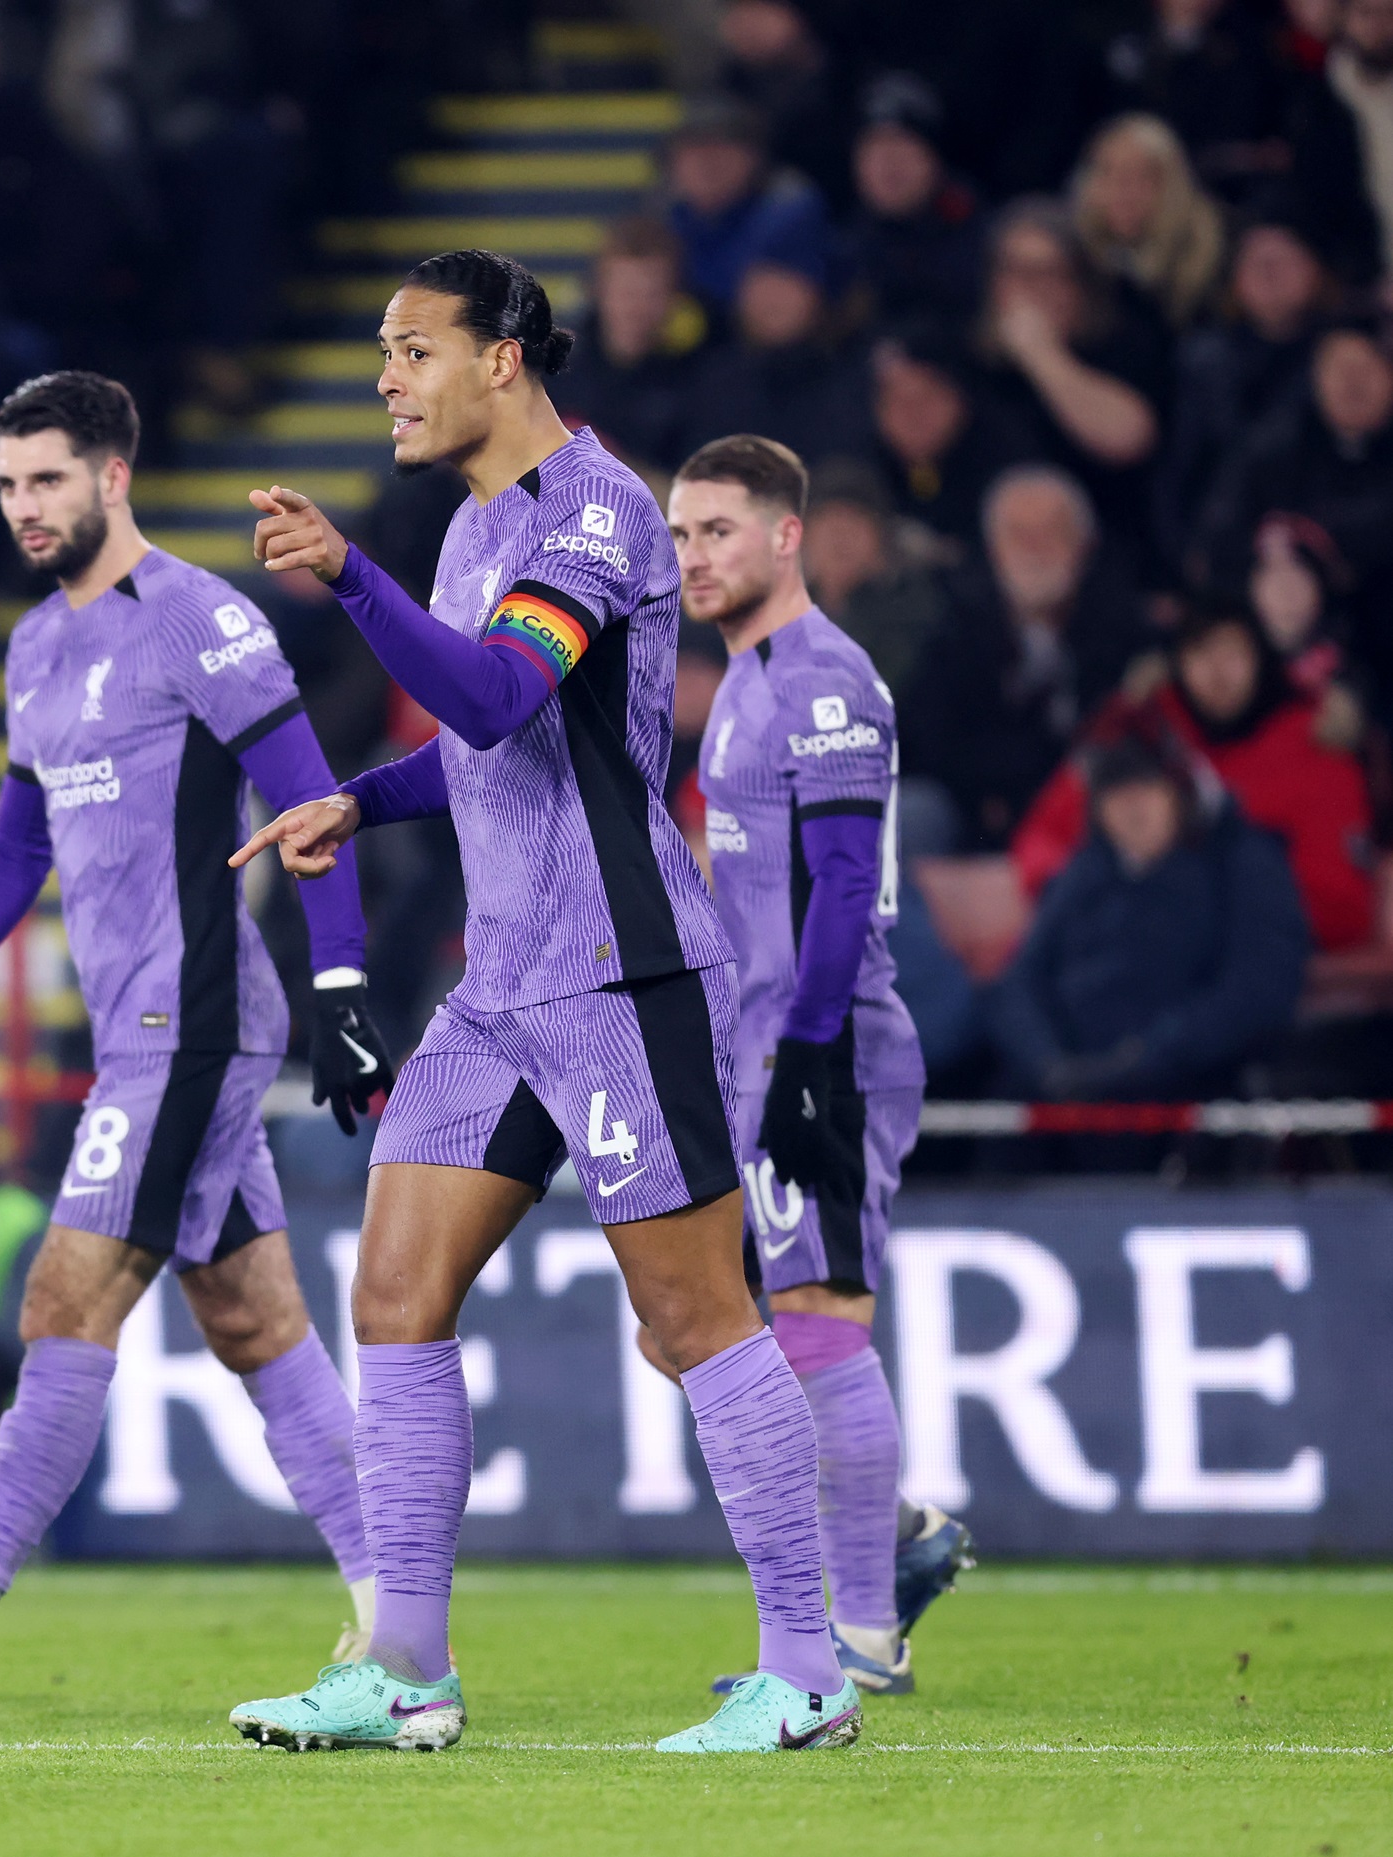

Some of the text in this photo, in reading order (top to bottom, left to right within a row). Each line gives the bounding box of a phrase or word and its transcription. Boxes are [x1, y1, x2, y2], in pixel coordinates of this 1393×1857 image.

[544, 530, 630, 576] Expedia
[788, 723, 879, 759] Expedia
[76, 1105, 130, 1181] 8
[587, 1090, 638, 1164] 4
[743, 1156, 804, 1236] 10
